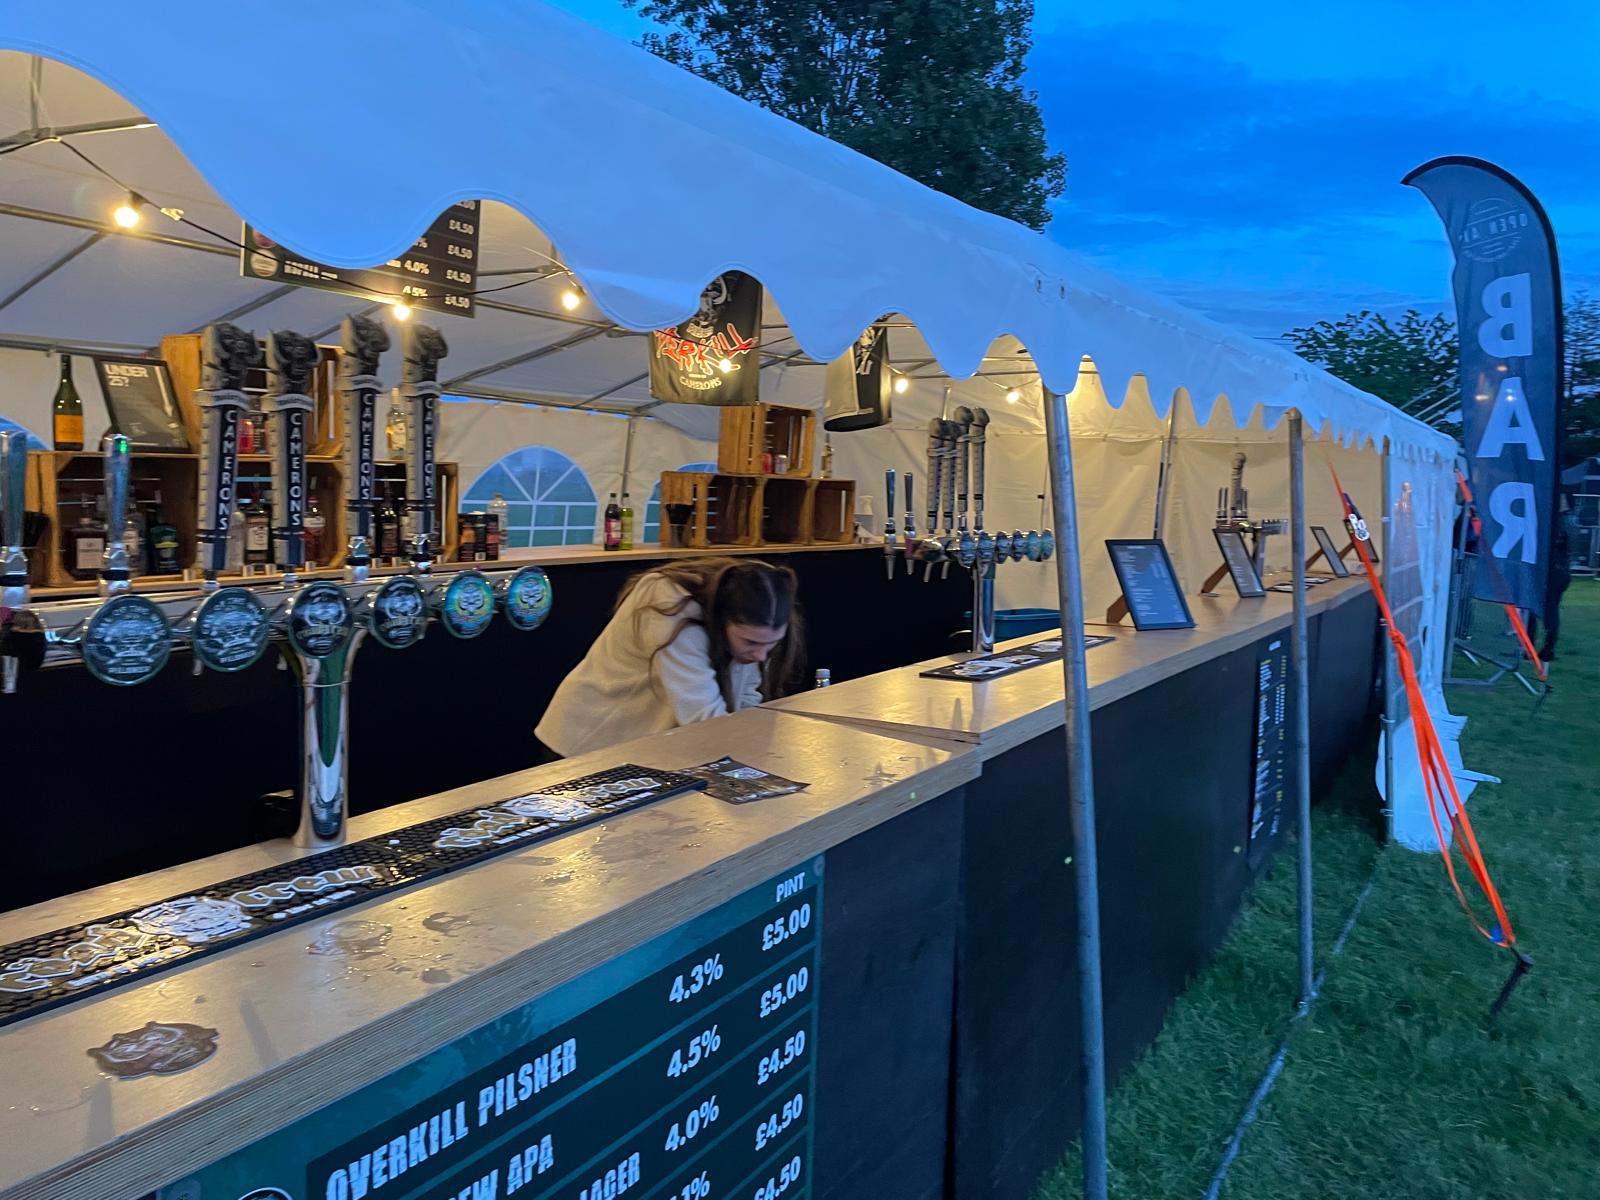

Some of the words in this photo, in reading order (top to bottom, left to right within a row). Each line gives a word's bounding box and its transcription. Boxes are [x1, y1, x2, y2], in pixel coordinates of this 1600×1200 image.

[104, 364, 149, 378] UNDER
[108, 375, 129, 387] 25?
[218, 409, 239, 531] CAMERONS
[288, 411, 303, 526] CAMERONS
[360, 392, 374, 500] CAMERONS
[422, 397, 434, 498] CAMERONS
[776, 872, 805, 902] PINT
[326, 1101, 469, 1200] OVERKILL
[477, 1037, 577, 1127] PILSNER
[669, 953, 724, 1003] 4.3%
[762, 903, 811, 951] £5.00
[507, 1134, 554, 1195] APA
[667, 1024, 721, 1078] 4.5%
[760, 966, 809, 1018] £5.00
[665, 1095, 720, 1151] 4.0%
[757, 1030, 806, 1085] £4.50
[755, 1093, 804, 1151] £4.50
